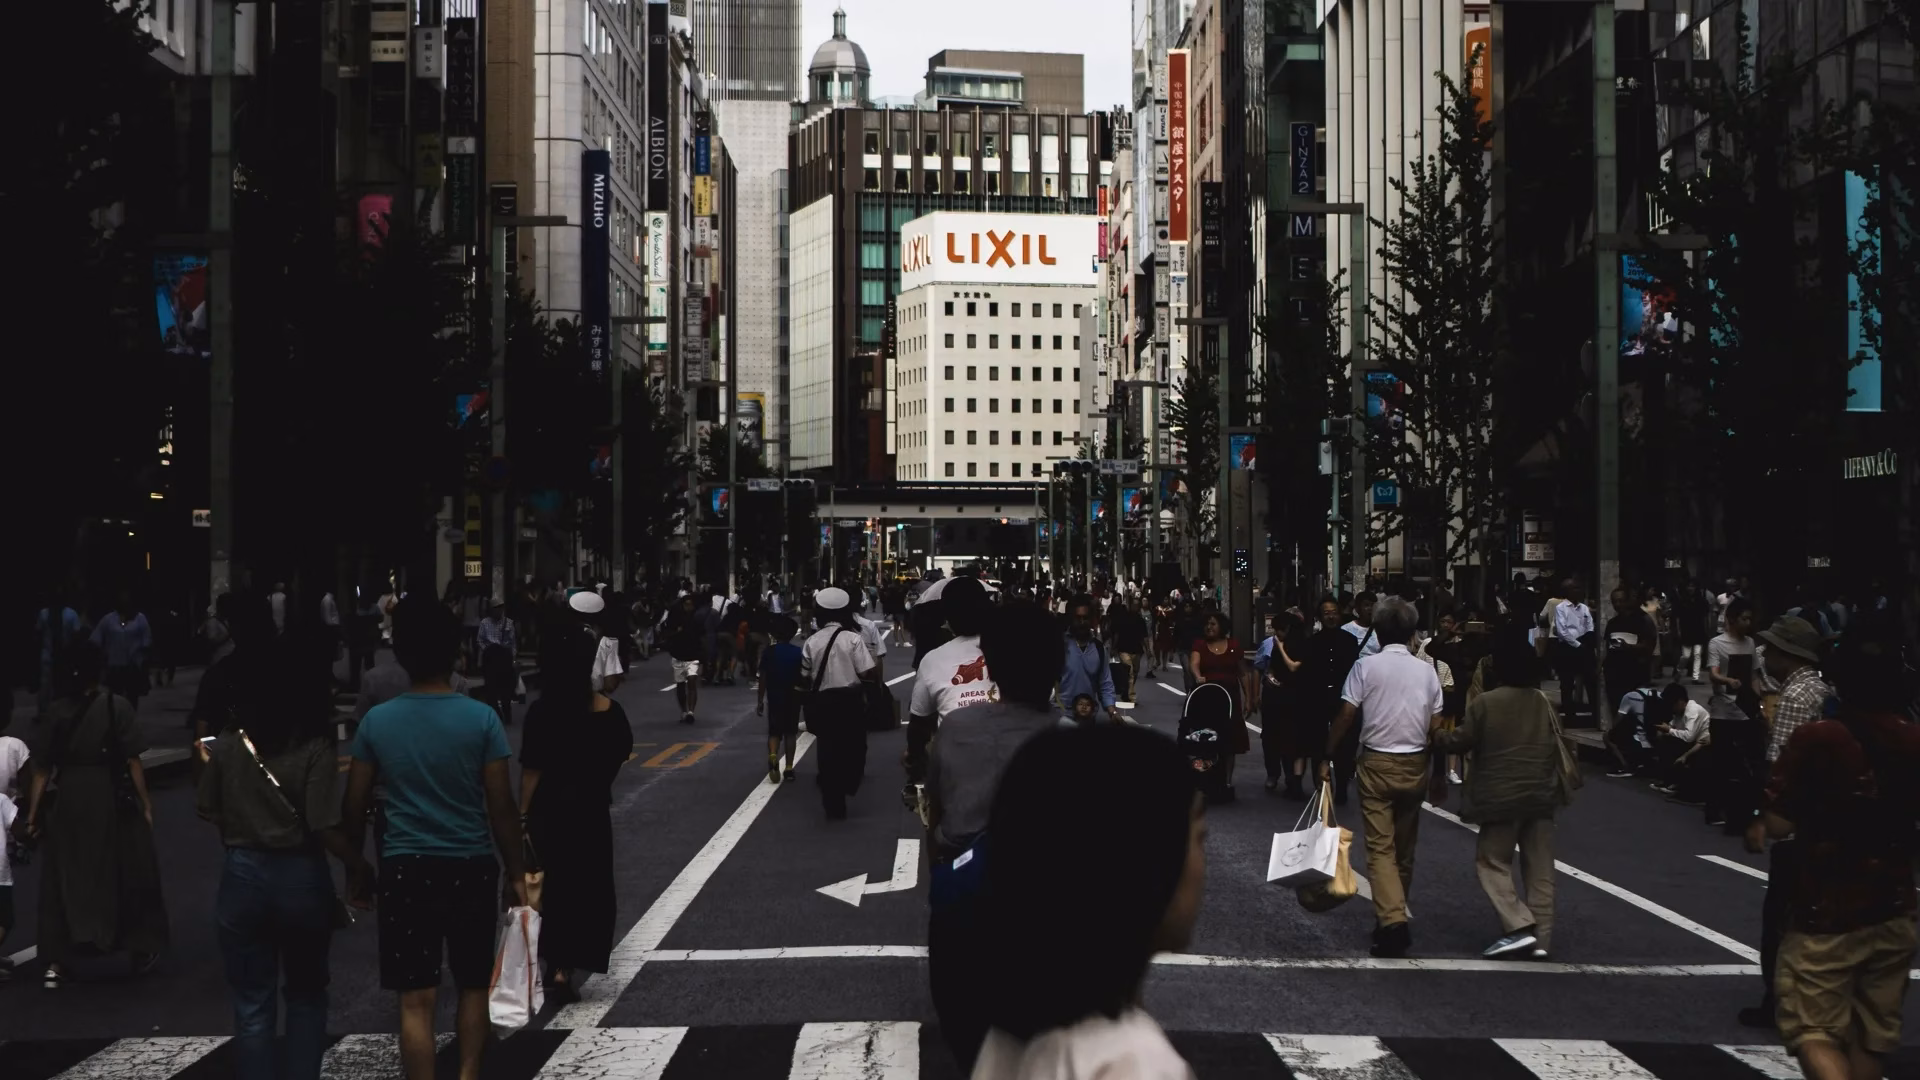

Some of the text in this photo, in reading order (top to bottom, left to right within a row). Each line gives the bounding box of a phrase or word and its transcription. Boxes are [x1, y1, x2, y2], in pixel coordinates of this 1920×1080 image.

[650, 116, 665, 180] ALBION
[1172, 126, 1185, 214] 銀座アスター
[593, 173, 605, 229] MIZUHO
[903, 234, 932, 274] LIXIL
[947, 229, 1057, 268] LIXIL
[960, 690, 986, 699] AREAS
